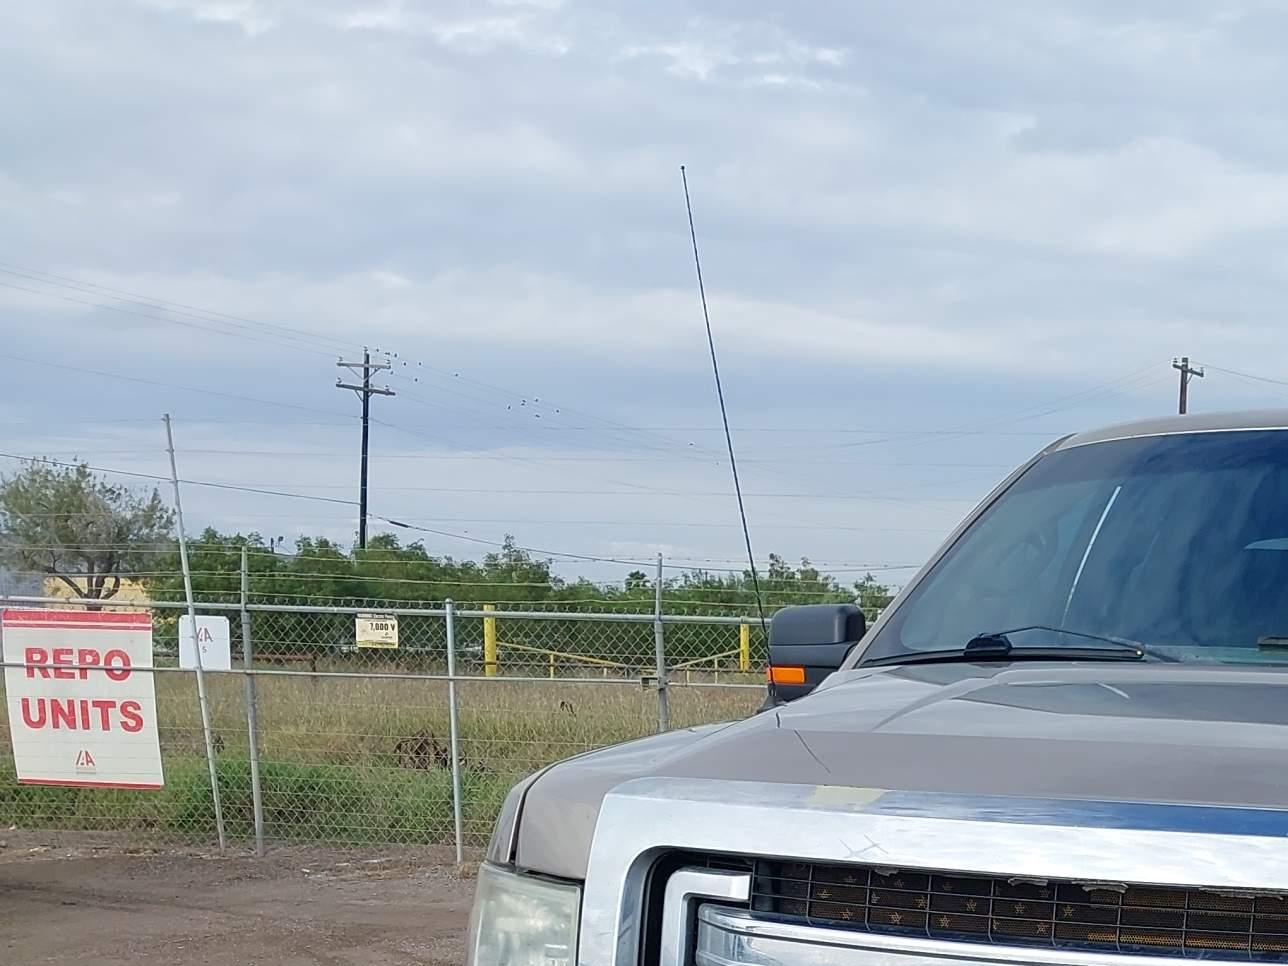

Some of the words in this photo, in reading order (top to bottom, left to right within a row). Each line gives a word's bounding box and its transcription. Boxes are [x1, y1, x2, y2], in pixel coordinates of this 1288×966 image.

[369, 622, 389, 632] 7,000
[390, 623, 396, 632] V
[25, 648, 132, 682] REPO
[21, 698, 144, 733] UNITS
